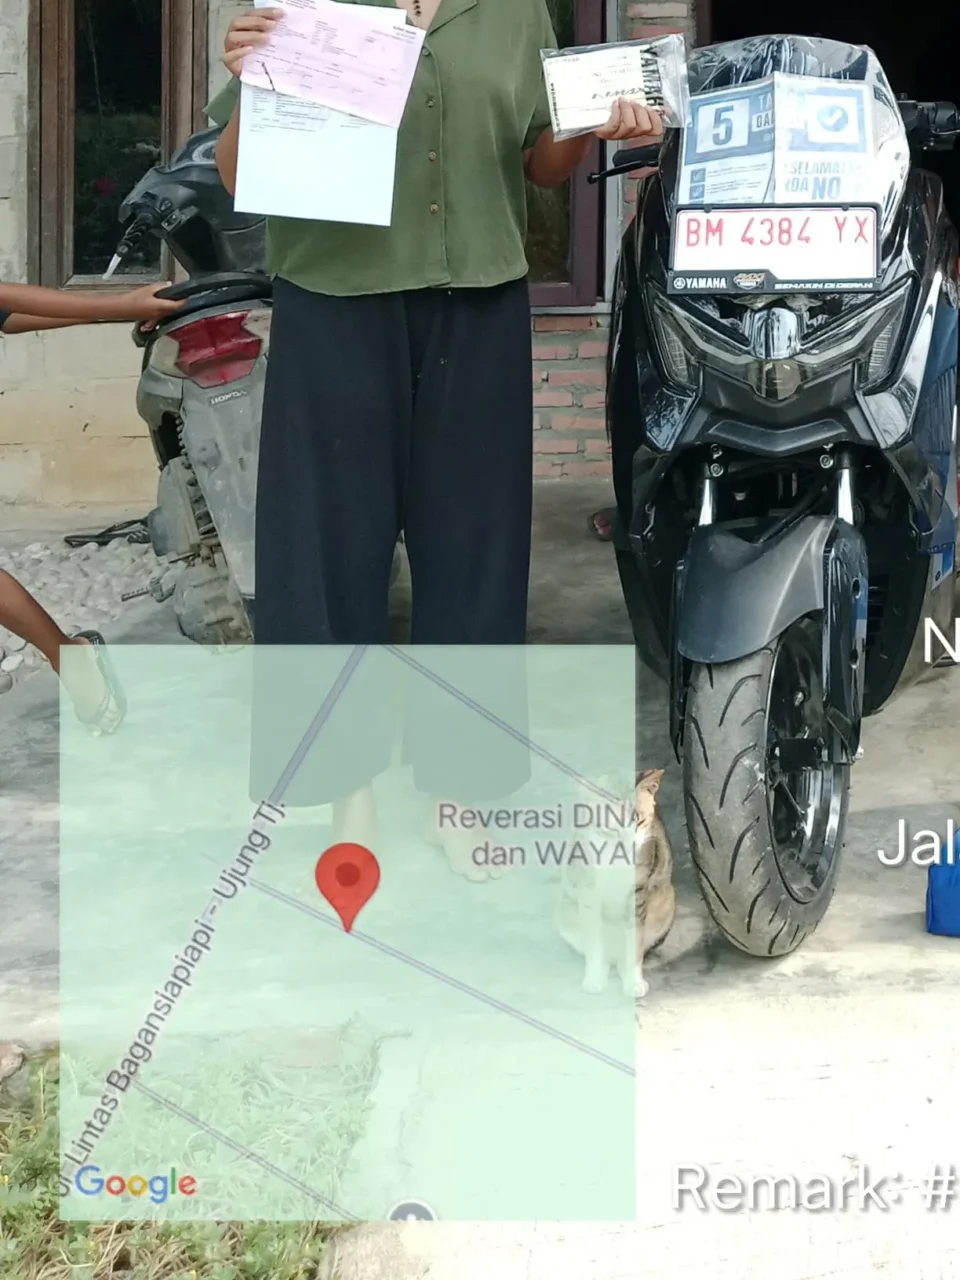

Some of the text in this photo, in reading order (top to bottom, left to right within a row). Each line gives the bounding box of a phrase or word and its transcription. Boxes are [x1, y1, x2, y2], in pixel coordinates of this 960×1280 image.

[712, 106, 734, 146] 5
[686, 216, 868, 247] BM 4384 YX
[686, 277, 727, 289] YAMAHA
[774, 282, 823, 290] SEMAKIN
